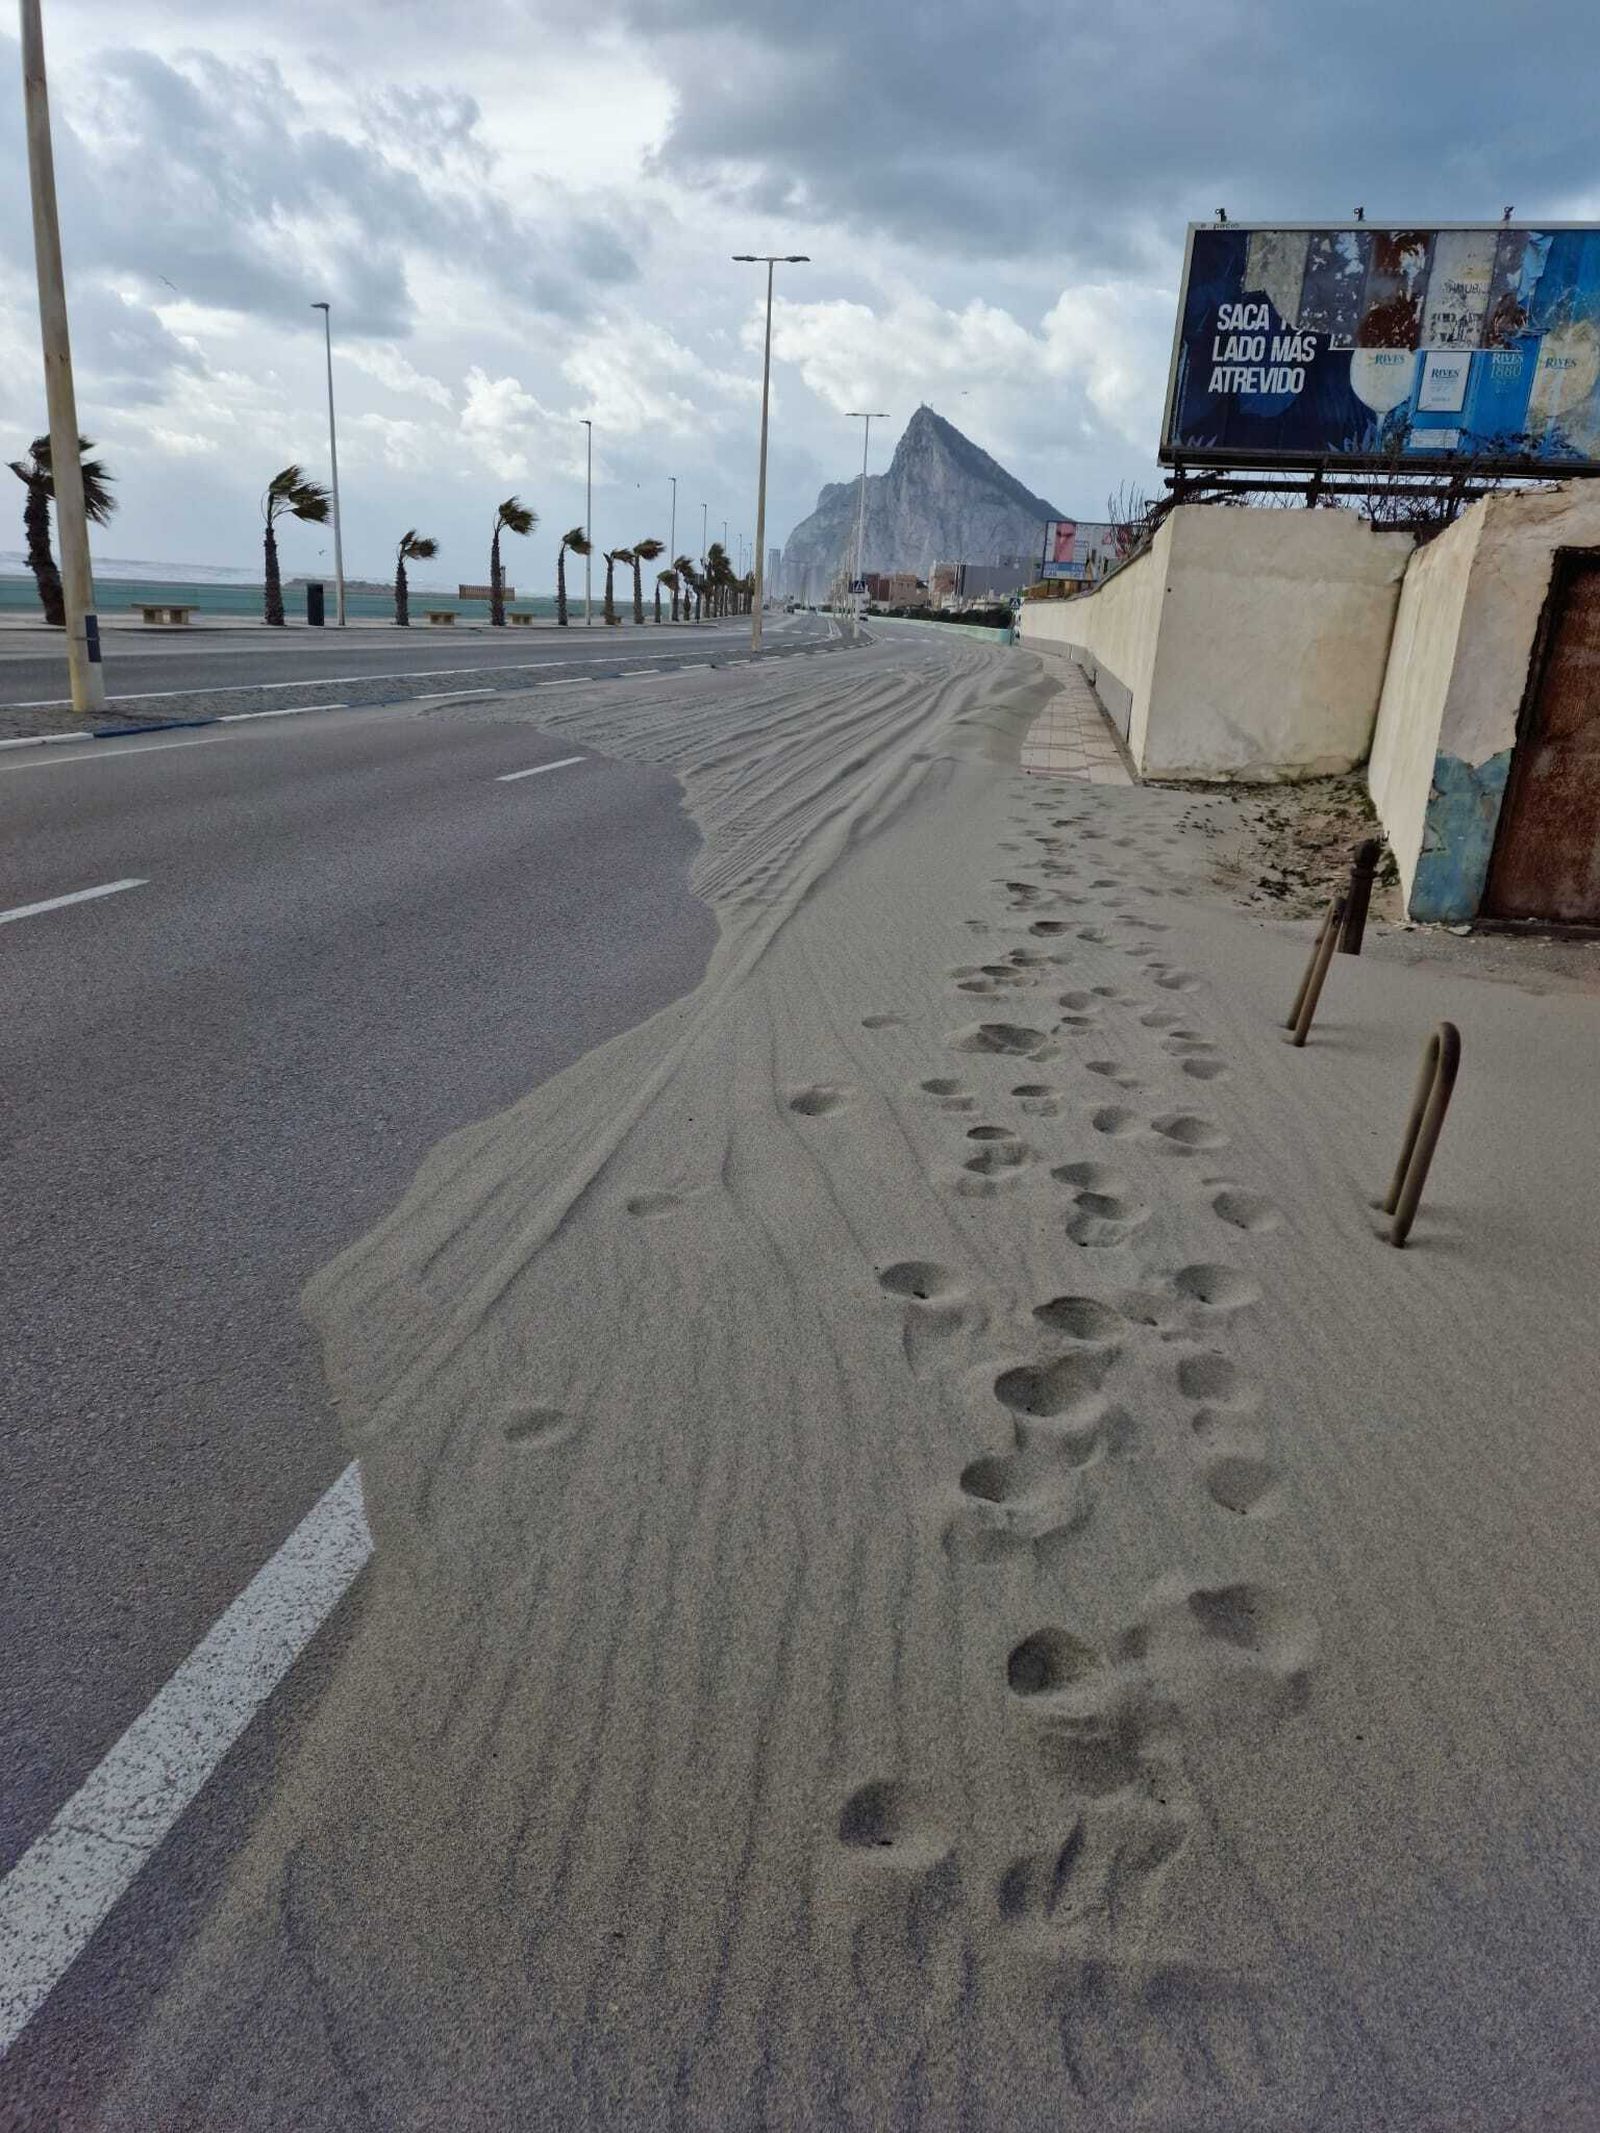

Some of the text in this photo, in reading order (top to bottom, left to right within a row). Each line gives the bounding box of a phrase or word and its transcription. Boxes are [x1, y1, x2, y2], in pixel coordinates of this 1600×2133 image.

[1217, 303, 1270, 330] SACA
[1212, 329, 1317, 362] LADO MÁS
[1375, 353, 1406, 366] RIVES
[1492, 352, 1524, 364] RIVES
[1545, 357, 1577, 369] RIVES
[1431, 367, 1460, 378] RIVES
[1207, 366, 1306, 394] ATREVIDO
